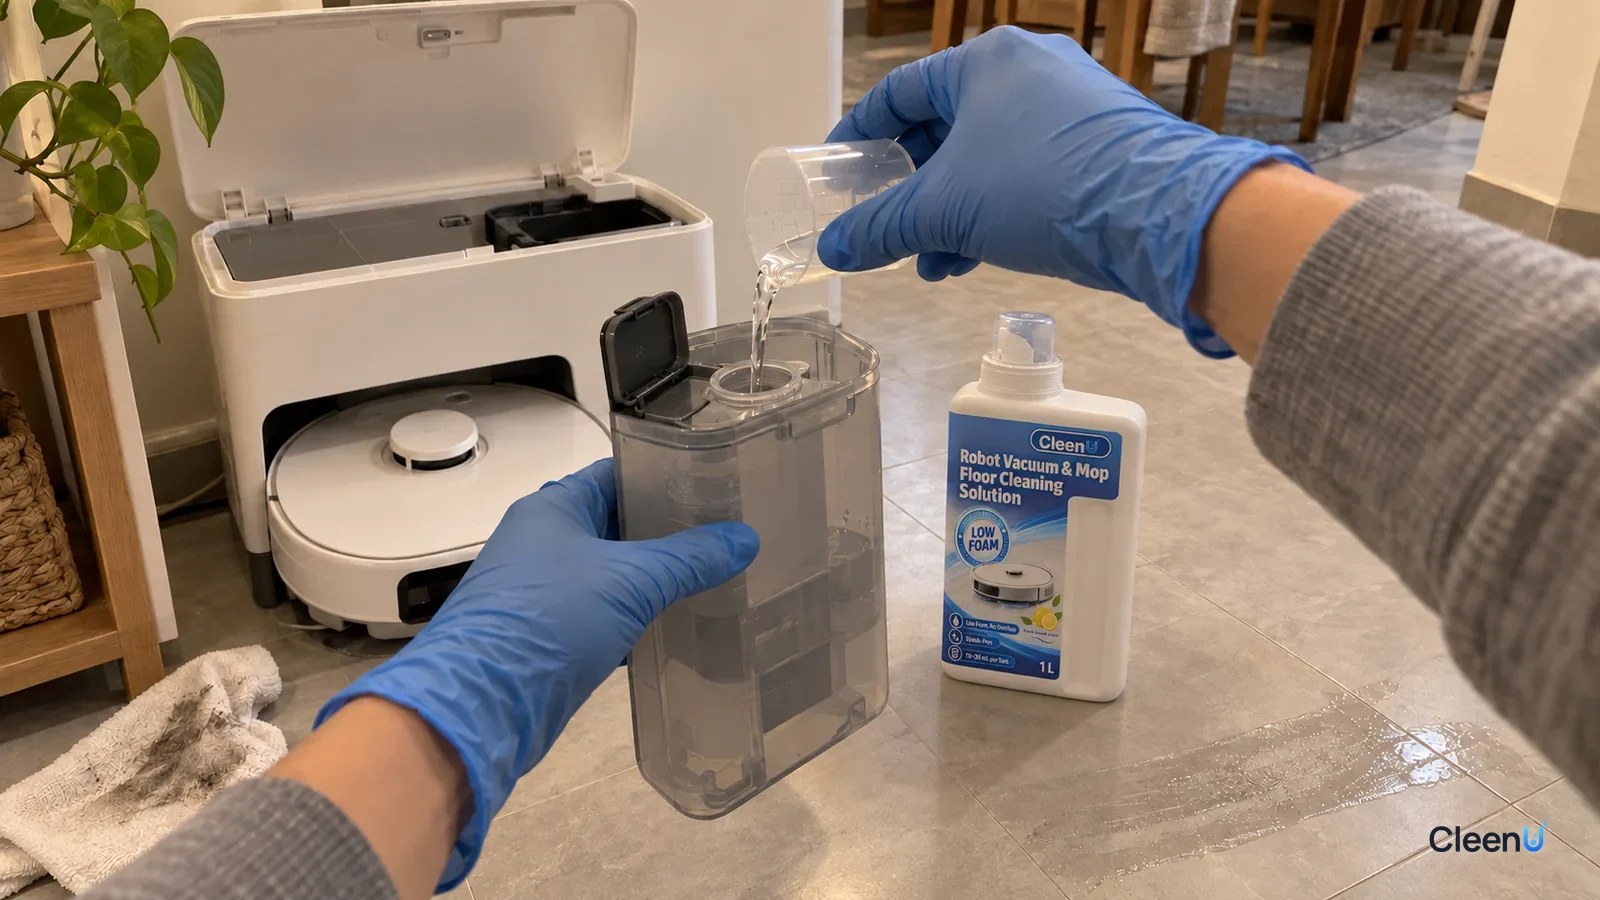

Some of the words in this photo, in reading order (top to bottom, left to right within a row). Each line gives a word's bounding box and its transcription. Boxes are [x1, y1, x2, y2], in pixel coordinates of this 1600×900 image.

[1039, 435, 1100, 454] CleenU
[960, 449, 1000, 468] Robot
[1003, 455, 1059, 475] Vacuum
[1061, 462, 1072, 476] &
[1076, 462, 1109, 484] Mop
[960, 467, 998, 485] Floor
[1000, 472, 1063, 496] Cleaning
[959, 483, 1021, 505] Solution
[972, 526, 995, 538] LOW
[969, 539, 998, 552] FOAM
